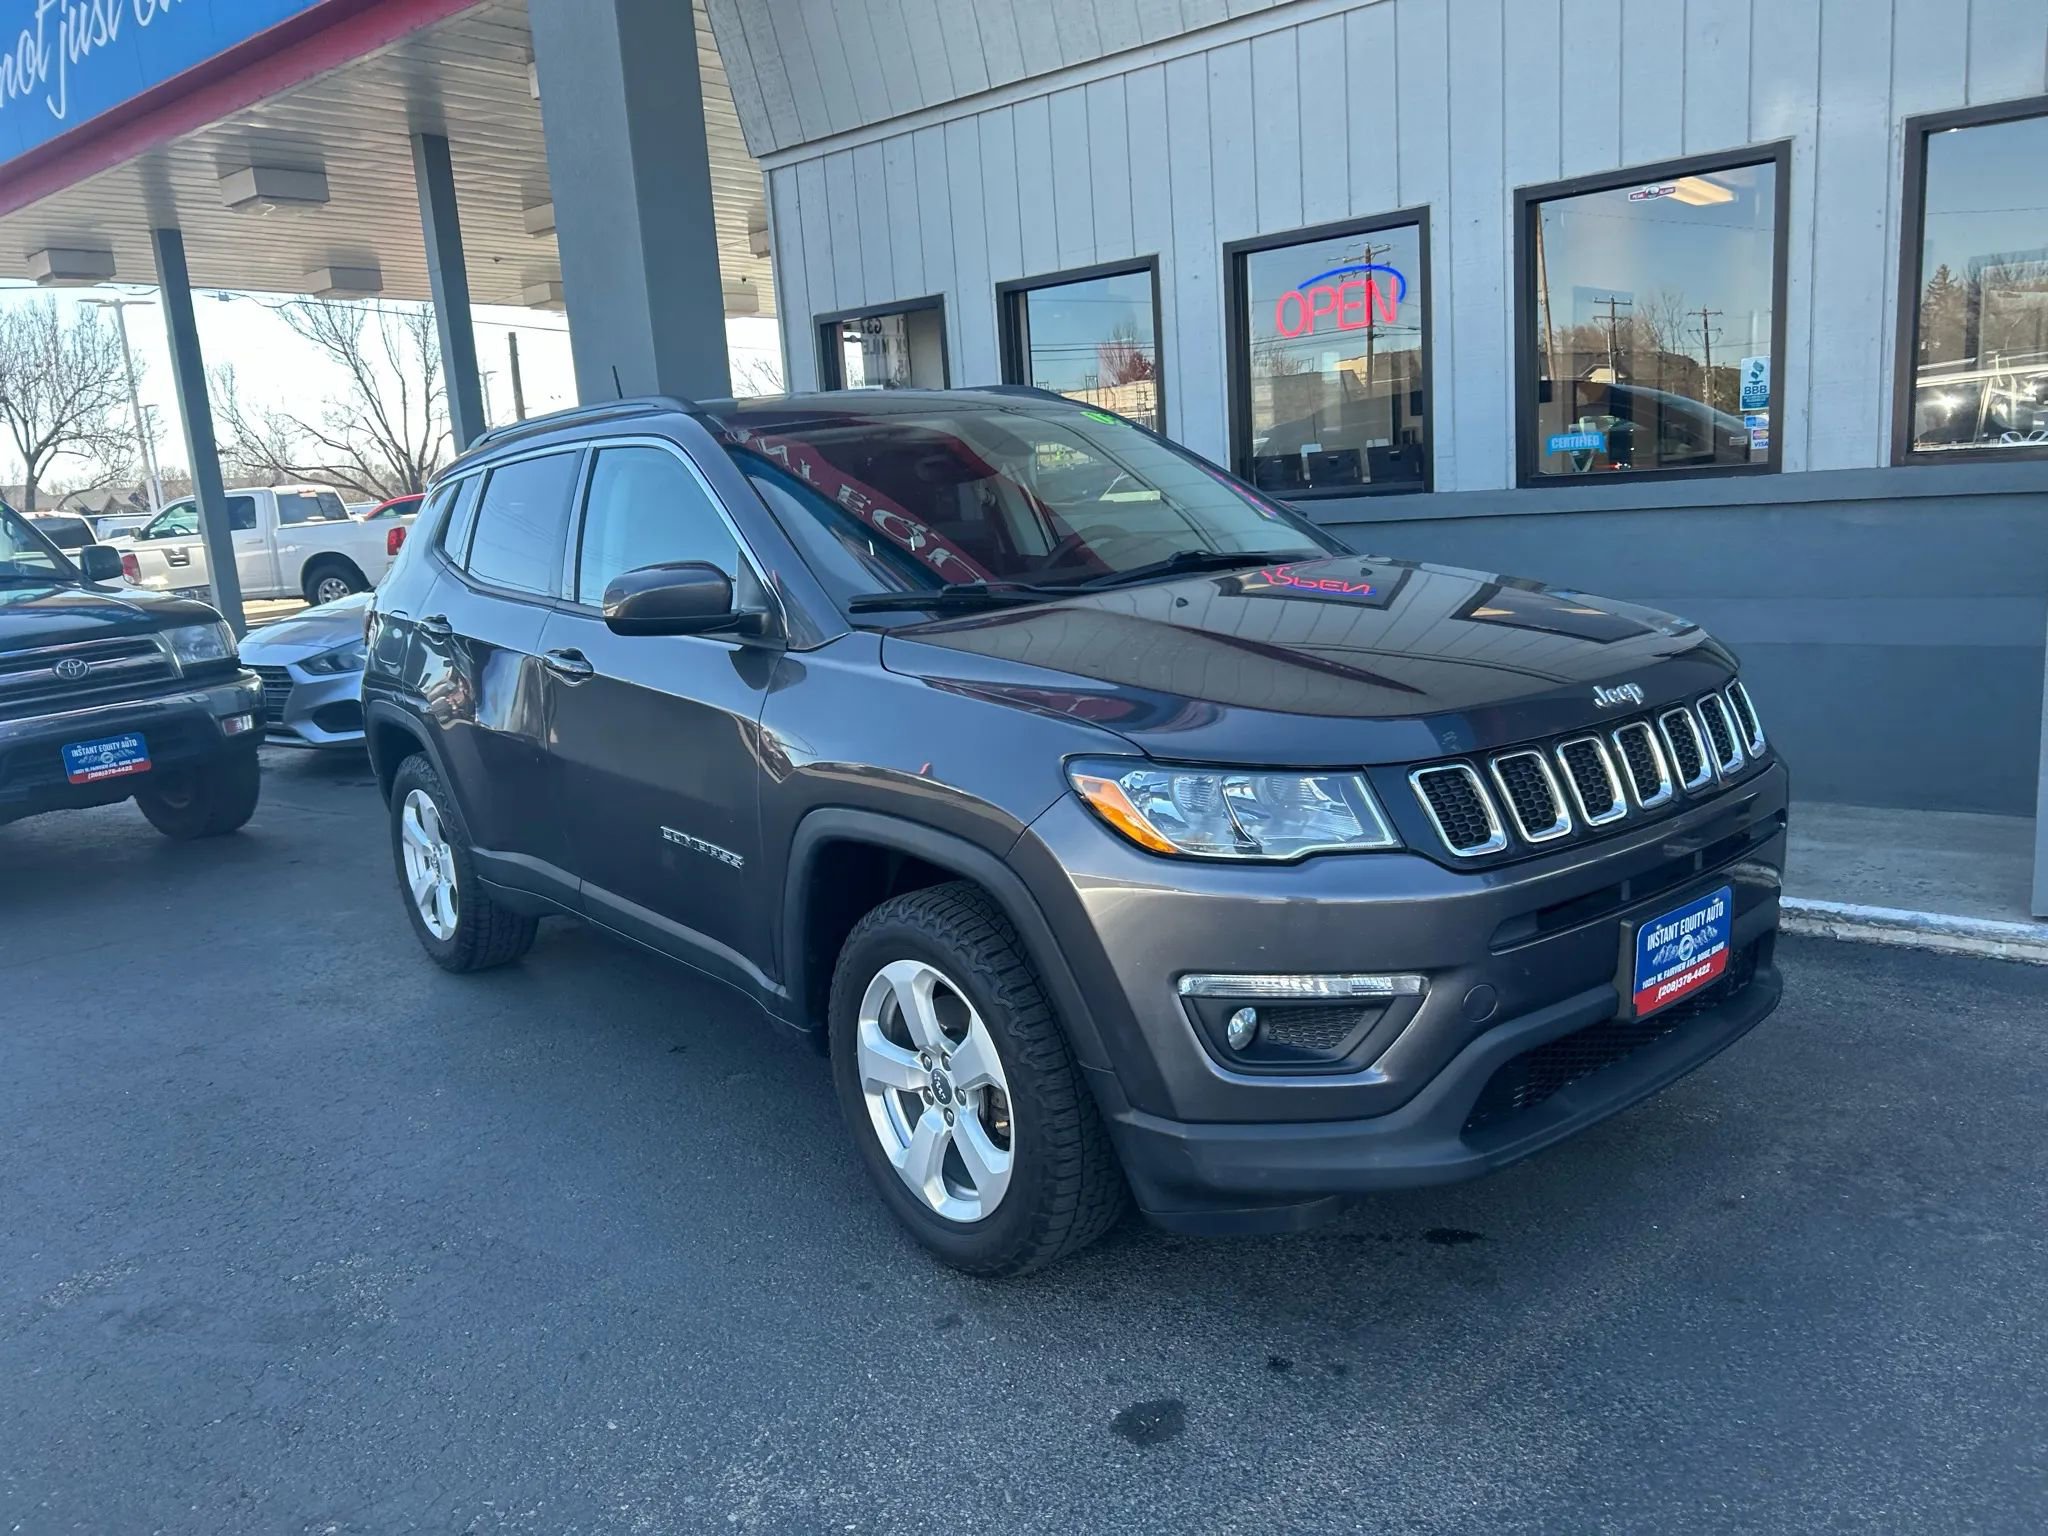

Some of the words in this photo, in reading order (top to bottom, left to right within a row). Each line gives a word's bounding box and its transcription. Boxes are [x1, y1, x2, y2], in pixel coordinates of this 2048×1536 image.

[0, 0, 55, 108] not
[1275, 275, 1398, 339] OPEN
[1744, 385, 1768, 395] BBB
[1551, 434, 1600, 449] CERTIFIED
[1593, 682, 1644, 708] Jeep
[71, 745, 99, 758] INSTANT
[99, 741, 120, 753] EQUITY
[121, 739, 138, 749] AUTO
[660, 825, 744, 870] COMPASS
[1647, 921, 1680, 952] INSTANT
[1680, 909, 1707, 936] EQUITY
[1706, 901, 1724, 924] AUTO
